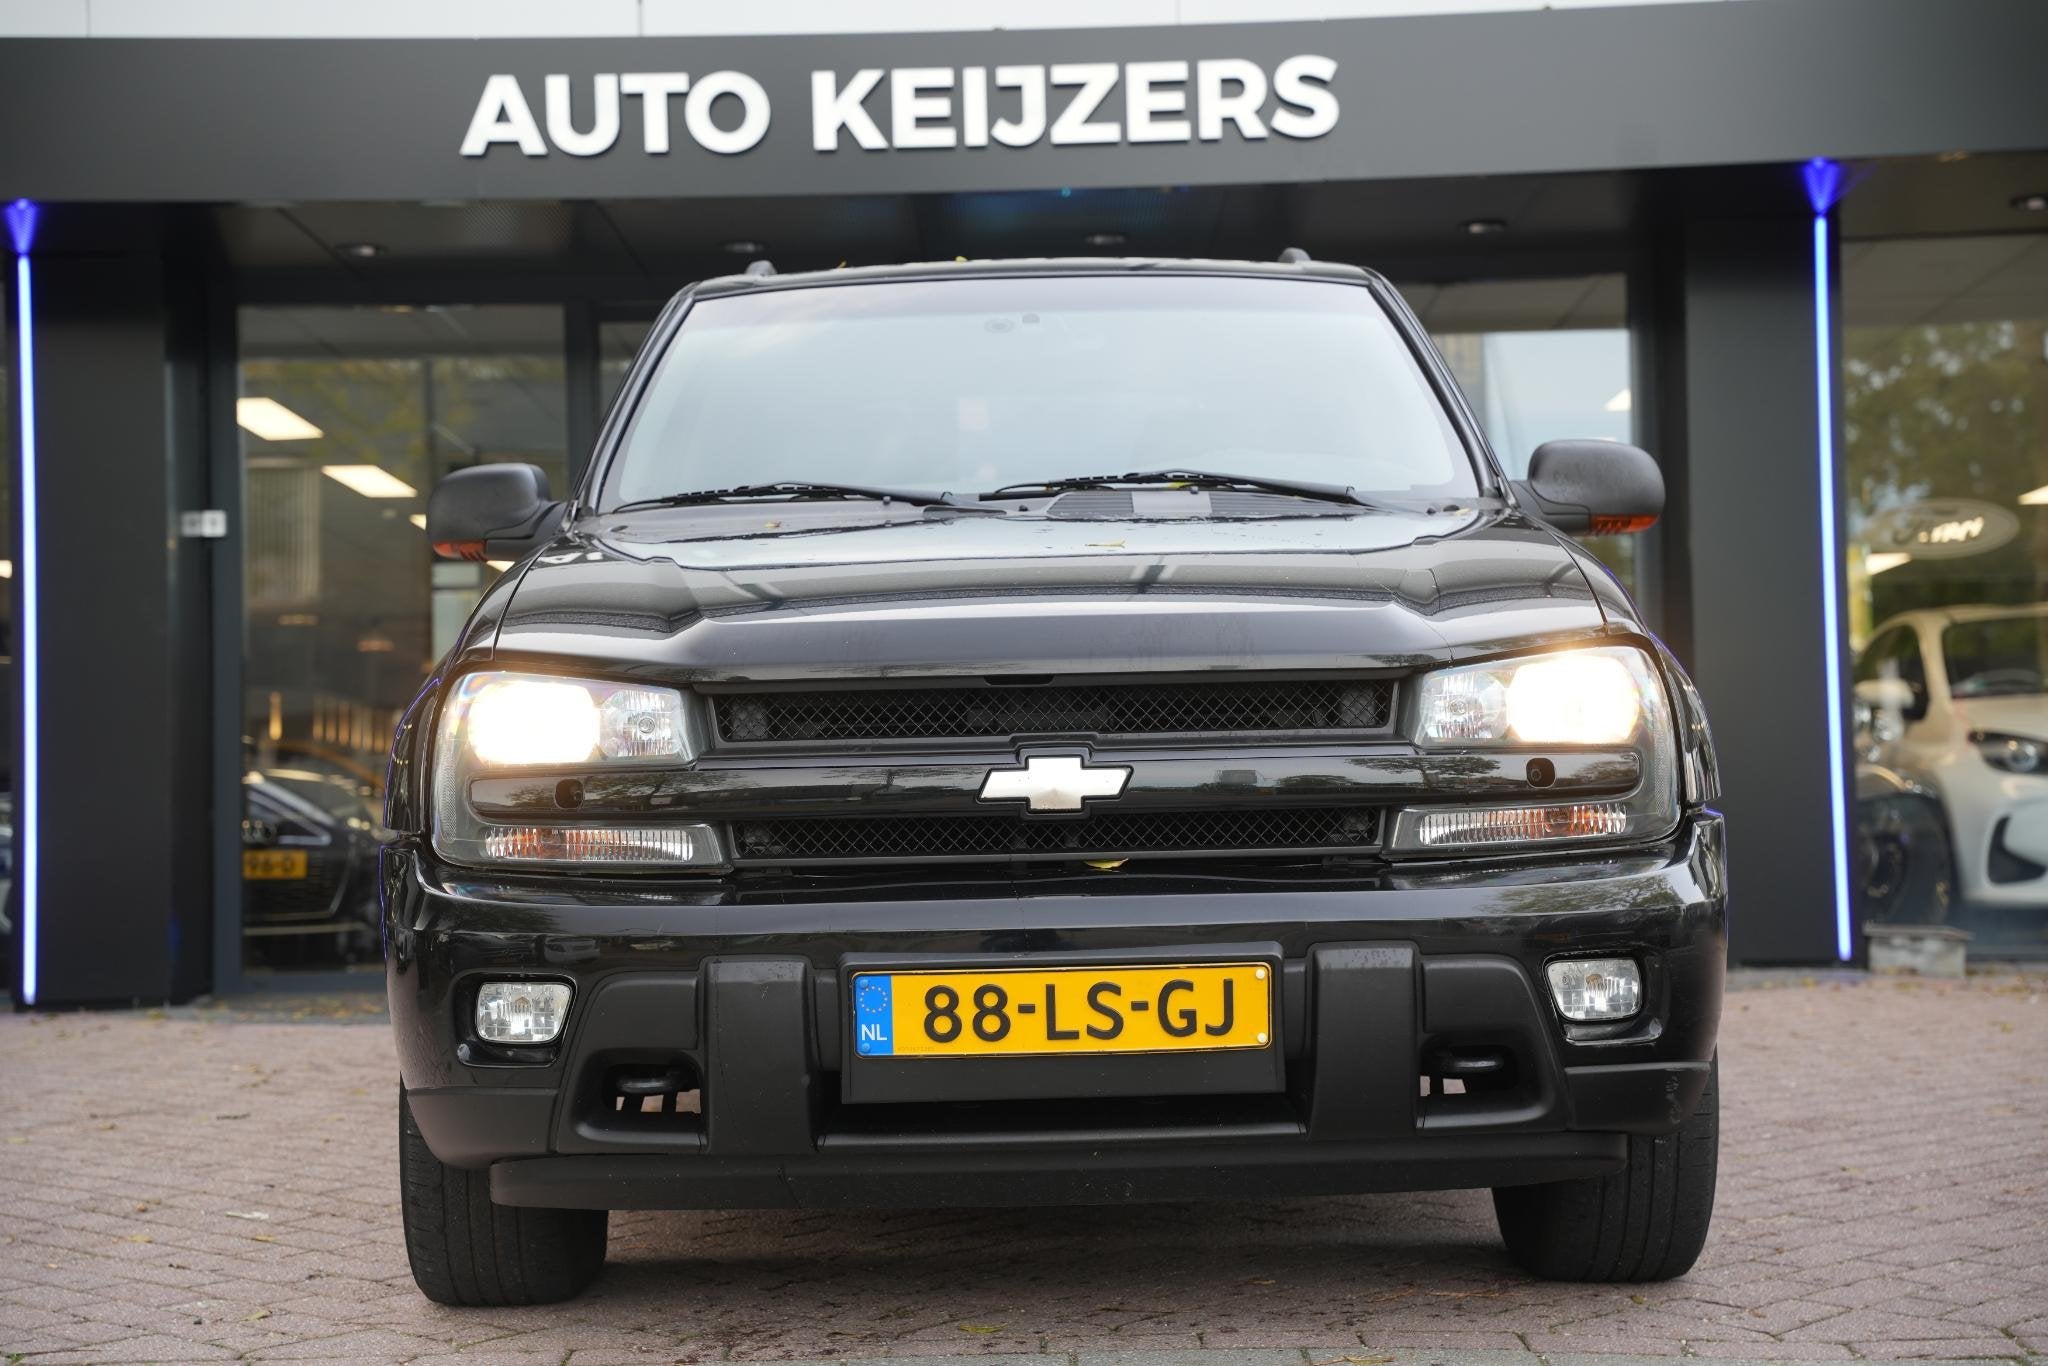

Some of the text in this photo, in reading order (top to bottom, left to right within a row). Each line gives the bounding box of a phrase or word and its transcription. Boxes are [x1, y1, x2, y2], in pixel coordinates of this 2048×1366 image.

[461, 54, 1341, 156] AUTO KEIJZERS
[861, 1023, 888, 1041] NL
[923, 978, 1235, 1044] 88-LS-GJ
